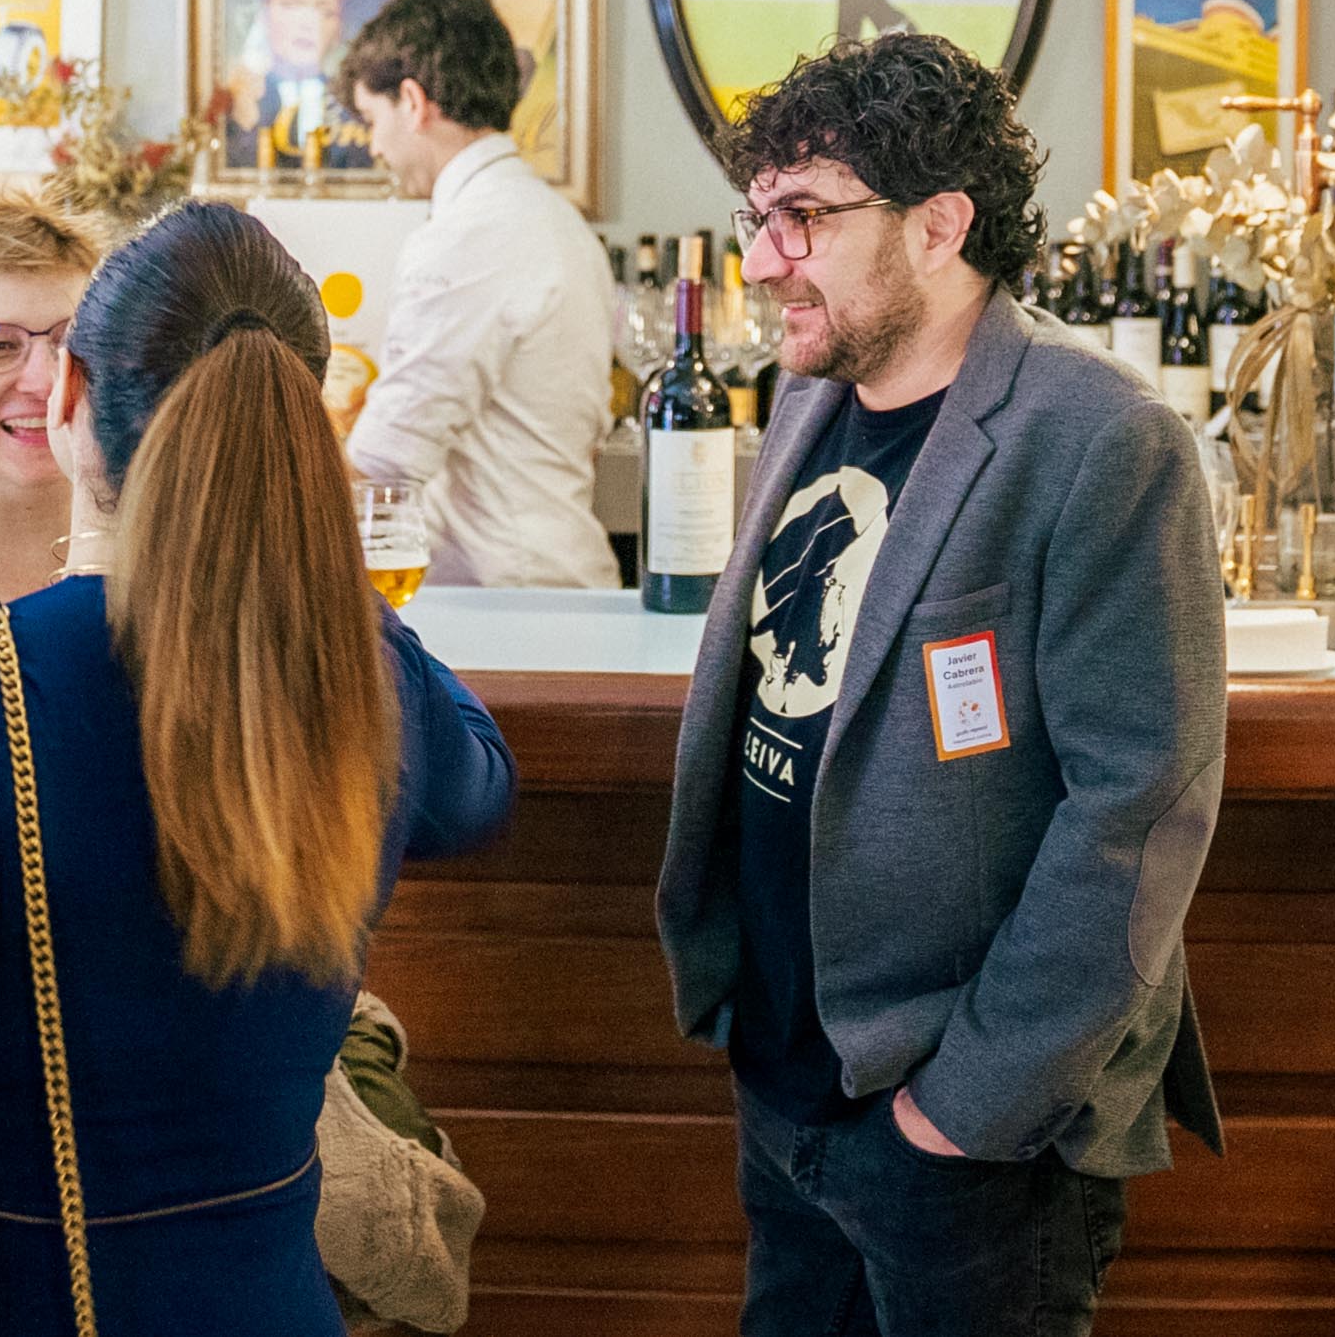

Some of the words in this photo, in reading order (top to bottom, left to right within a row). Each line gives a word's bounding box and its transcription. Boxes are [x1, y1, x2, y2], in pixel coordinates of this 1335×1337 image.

[947, 652, 978, 666] Javier
[942, 664, 986, 681] Cabrera
[744, 730, 795, 787] LEIVA
